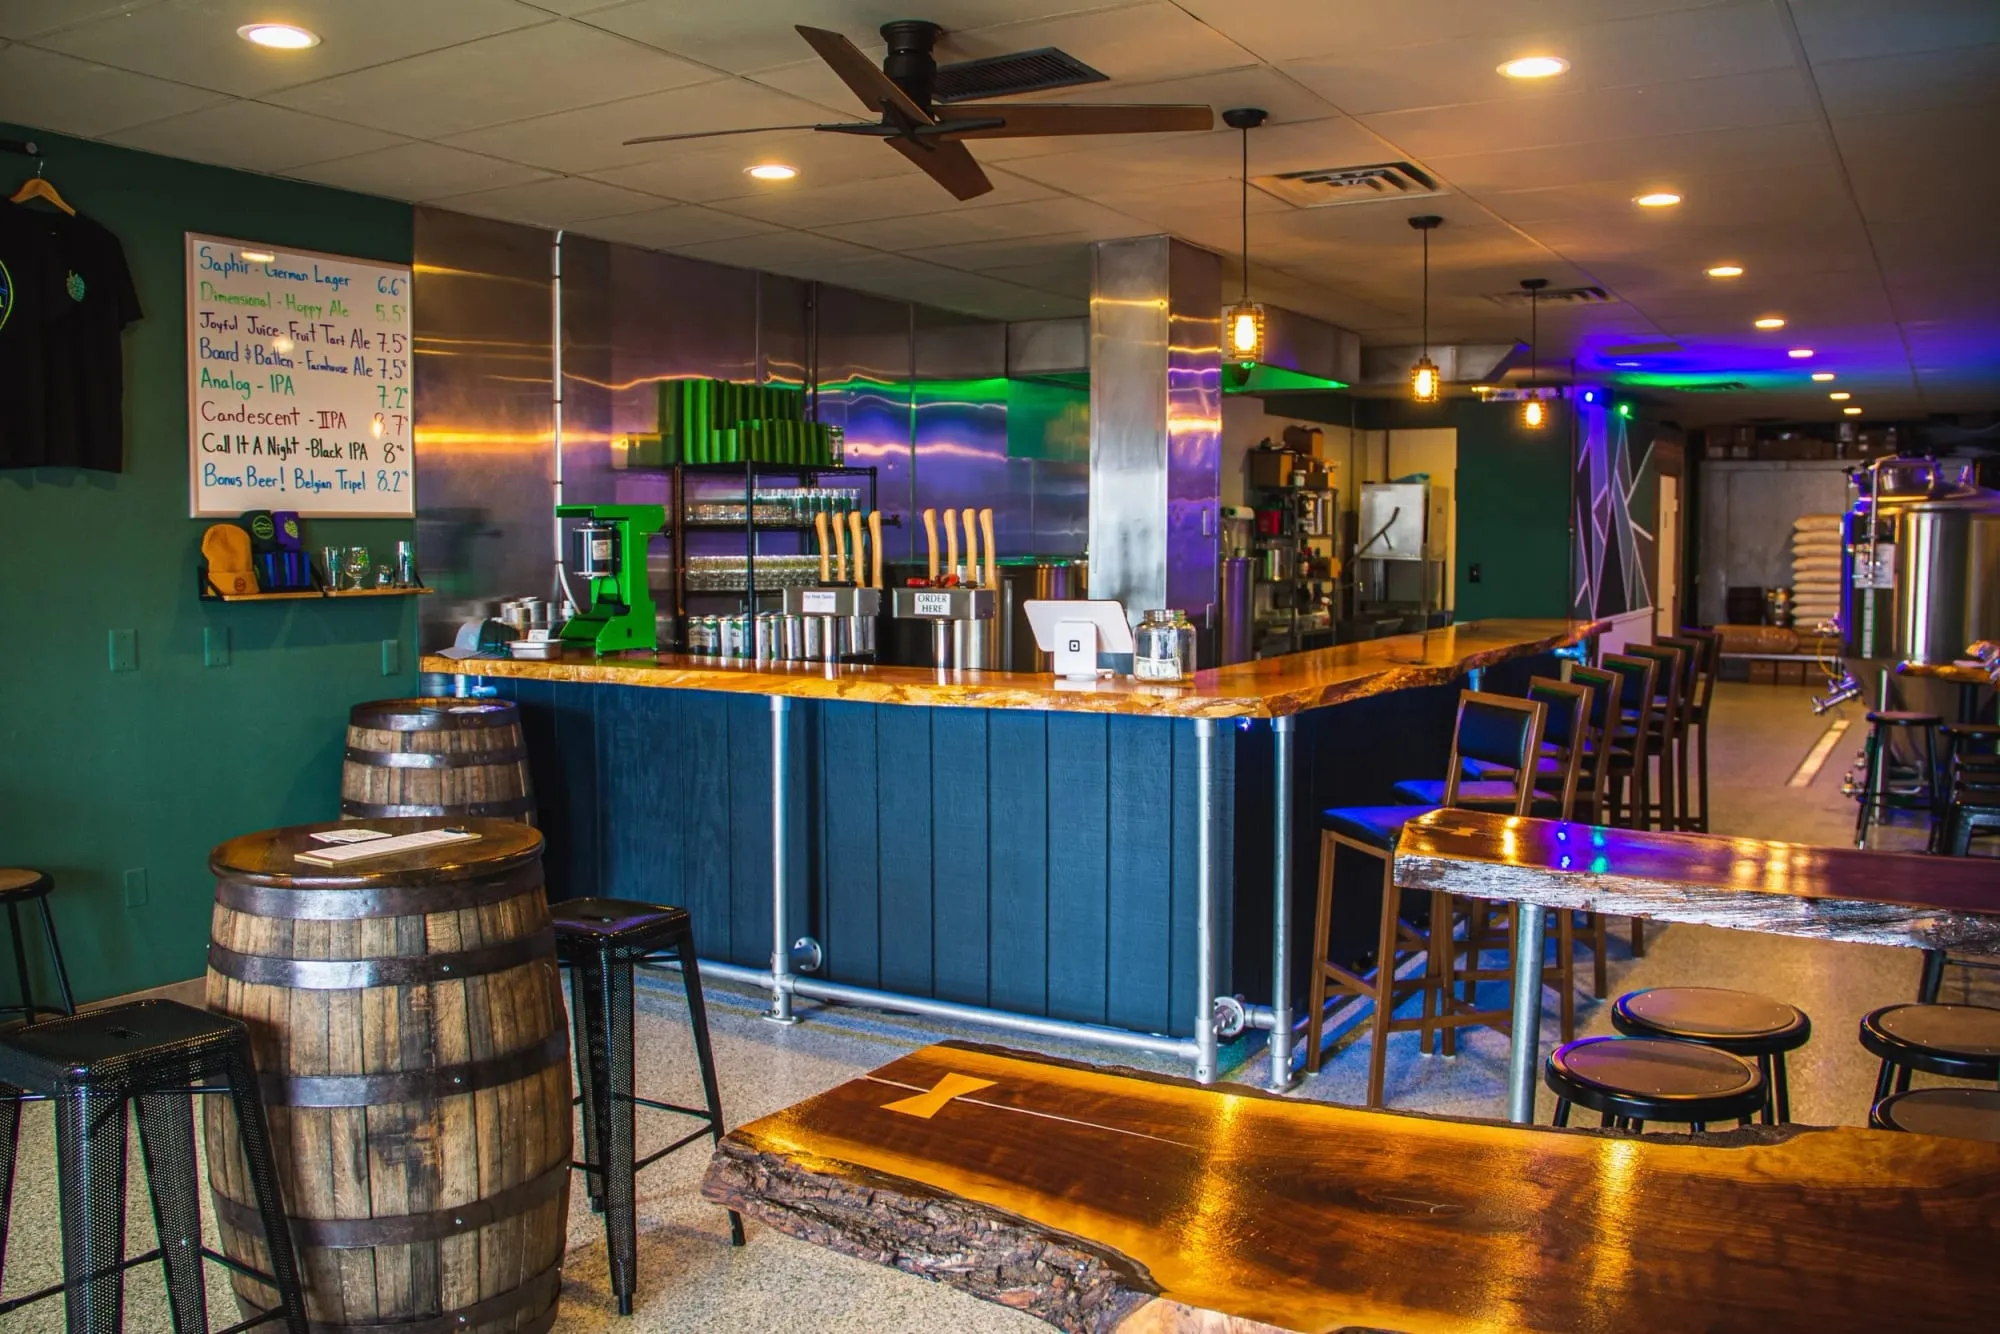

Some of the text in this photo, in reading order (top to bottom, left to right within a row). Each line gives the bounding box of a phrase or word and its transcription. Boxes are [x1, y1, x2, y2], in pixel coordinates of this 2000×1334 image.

[200, 246, 250, 279] Saphir
[314, 264, 350, 292] Lager
[200, 281, 271, 309] Dimensional
[285, 293, 322, 319] Hoppy
[329, 300, 349, 318] Ale
[200, 312, 238, 334] Joyful
[289, 321, 315, 342] Fruit
[320, 324, 345, 346] Tart
[350, 328, 371, 350] Ale
[200, 337, 239, 362] Board
[306, 350, 349, 374] Farmhouse
[353, 356, 373, 377] Ale
[200, 367, 251, 400] Analog
[270, 374, 295, 396] IPA
[201, 400, 301, 426] Candescent
[202, 432, 231, 454] Call
[236, 435, 250, 455] It
[252, 436, 263, 455] A
[267, 434, 300, 461] Night
[349, 442, 369, 461] IPA
[204, 462, 242, 487] Bonus
[246, 465, 285, 492] Beer!
[294, 467, 332, 489] Belgian
[335, 468, 366, 494] Tripel
[918, 594, 947, 603] ORDER
[921, 604, 943, 613] HERE
